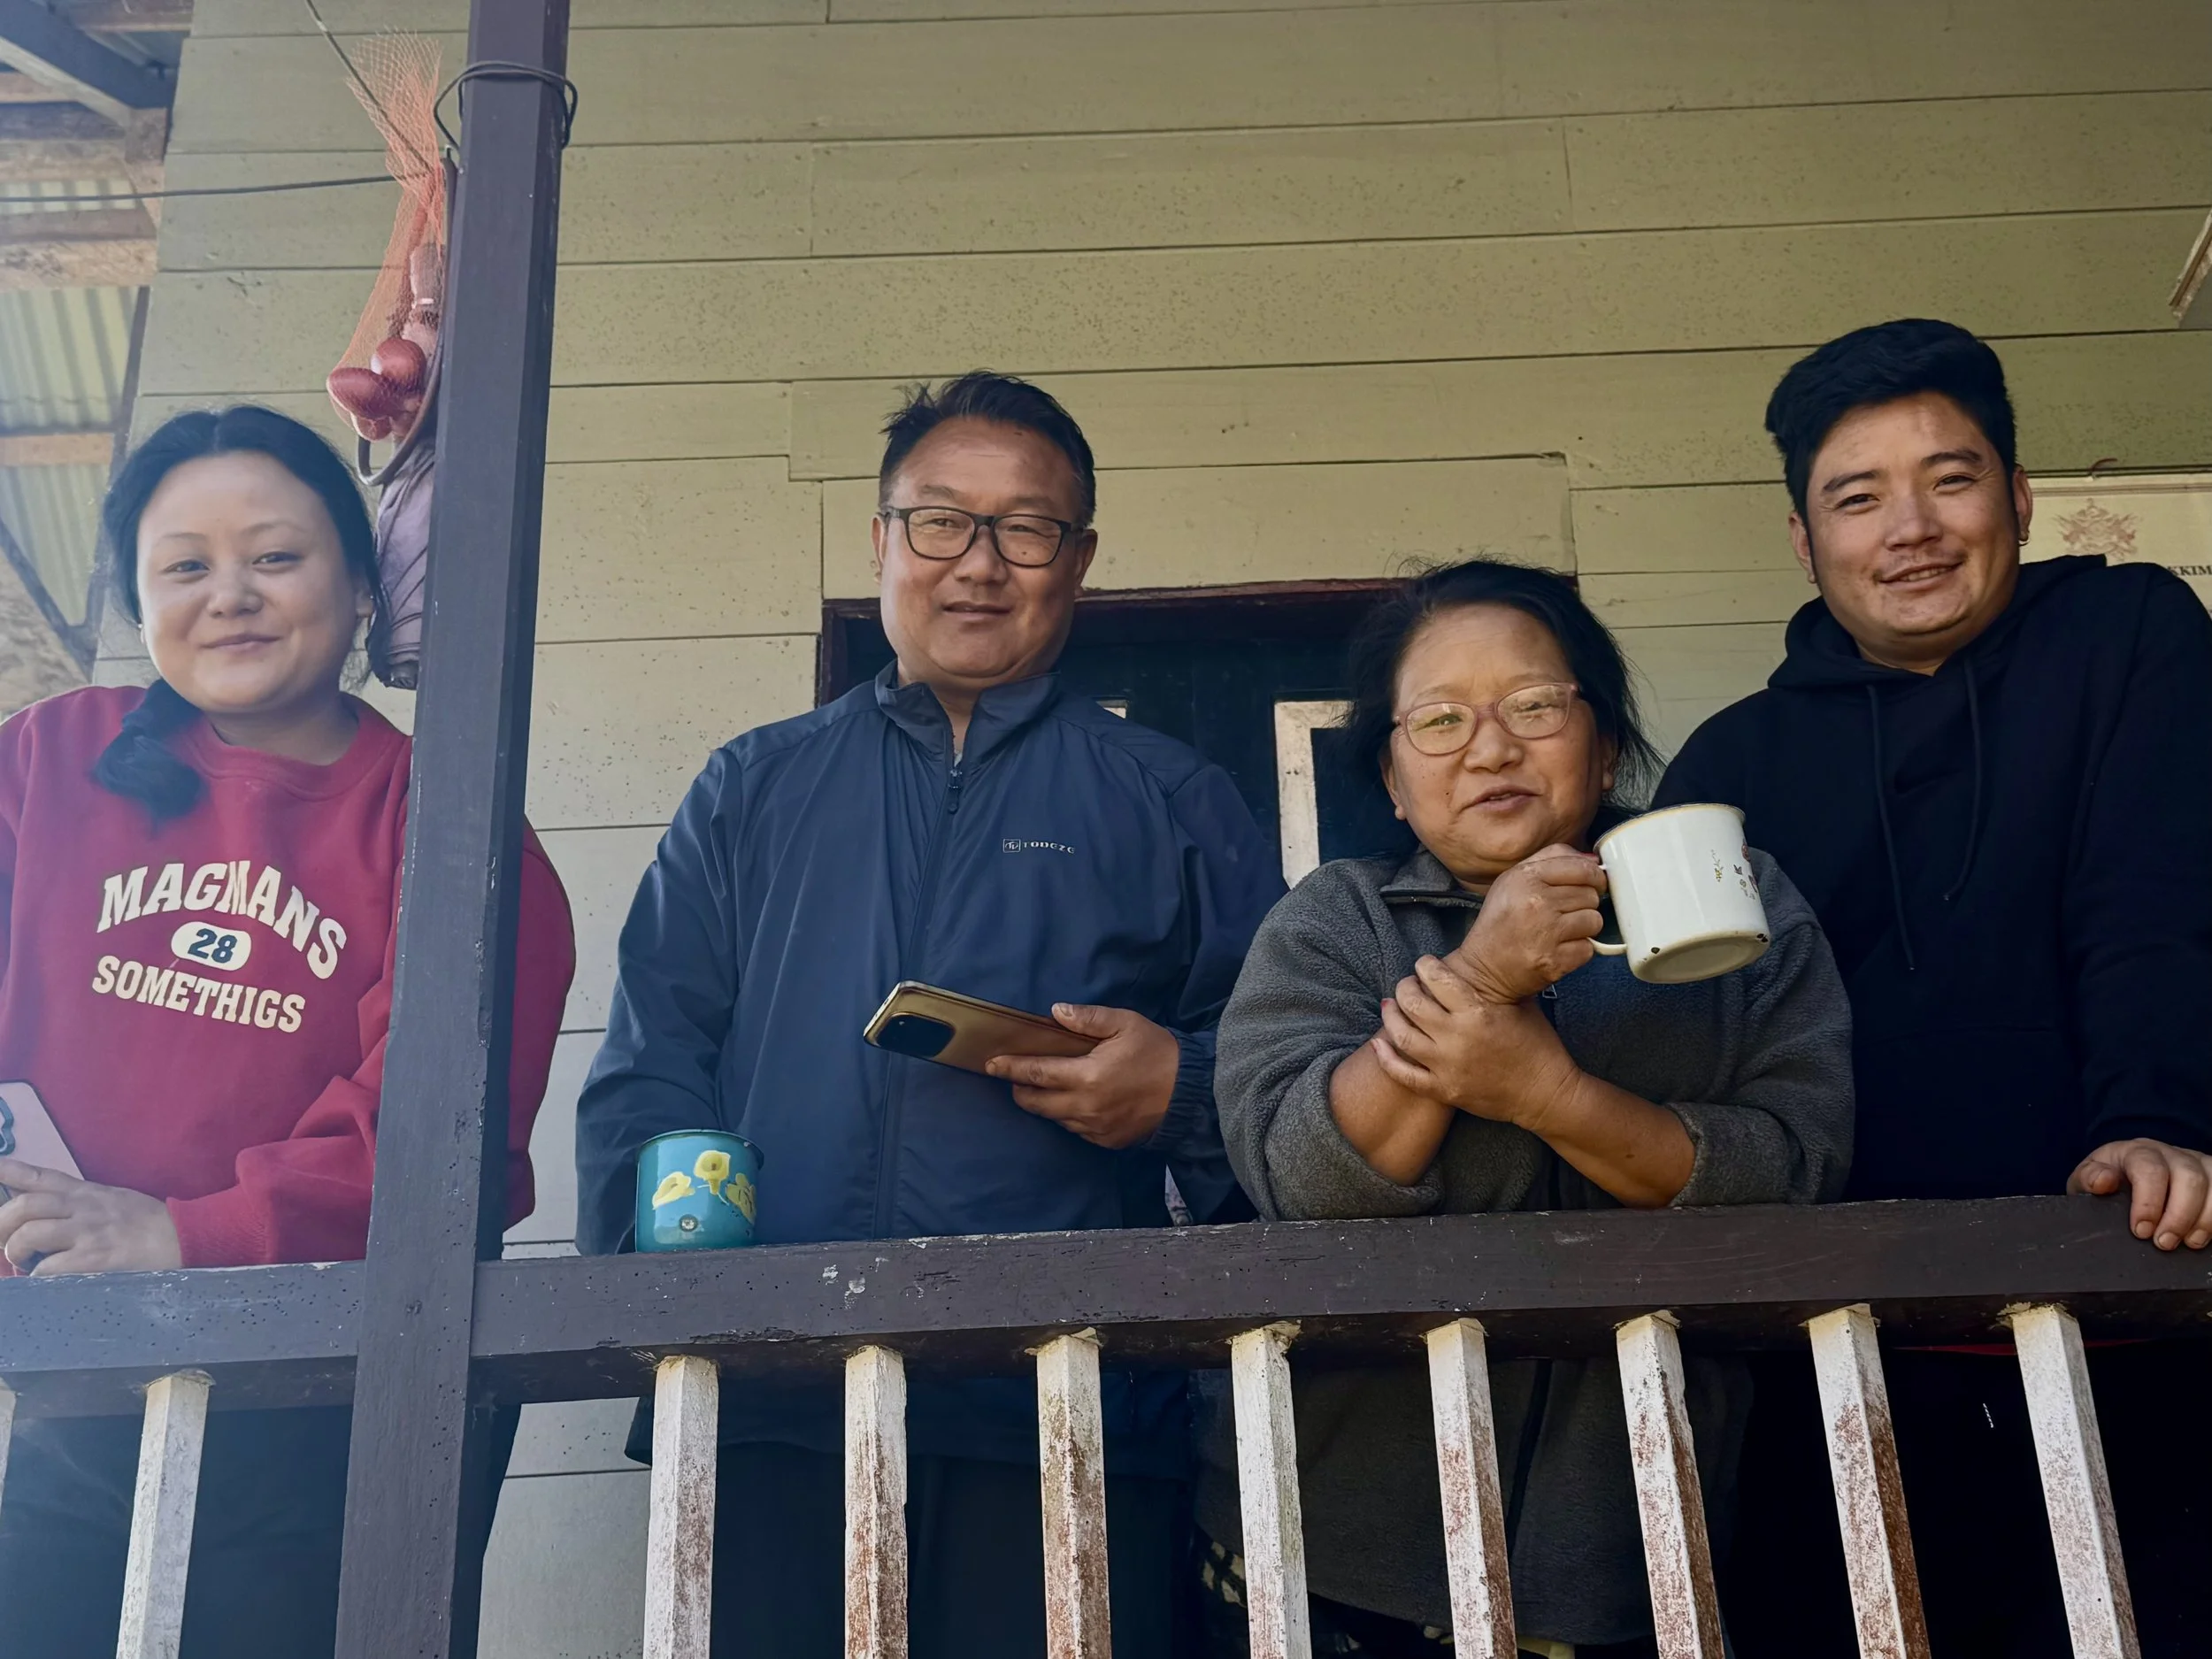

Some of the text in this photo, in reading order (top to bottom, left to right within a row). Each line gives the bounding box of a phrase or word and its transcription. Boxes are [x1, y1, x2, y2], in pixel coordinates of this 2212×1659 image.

[96, 860, 347, 979] MAGMANS
[188, 928, 238, 964] 28
[92, 955, 306, 1033] SOMETHIGS
